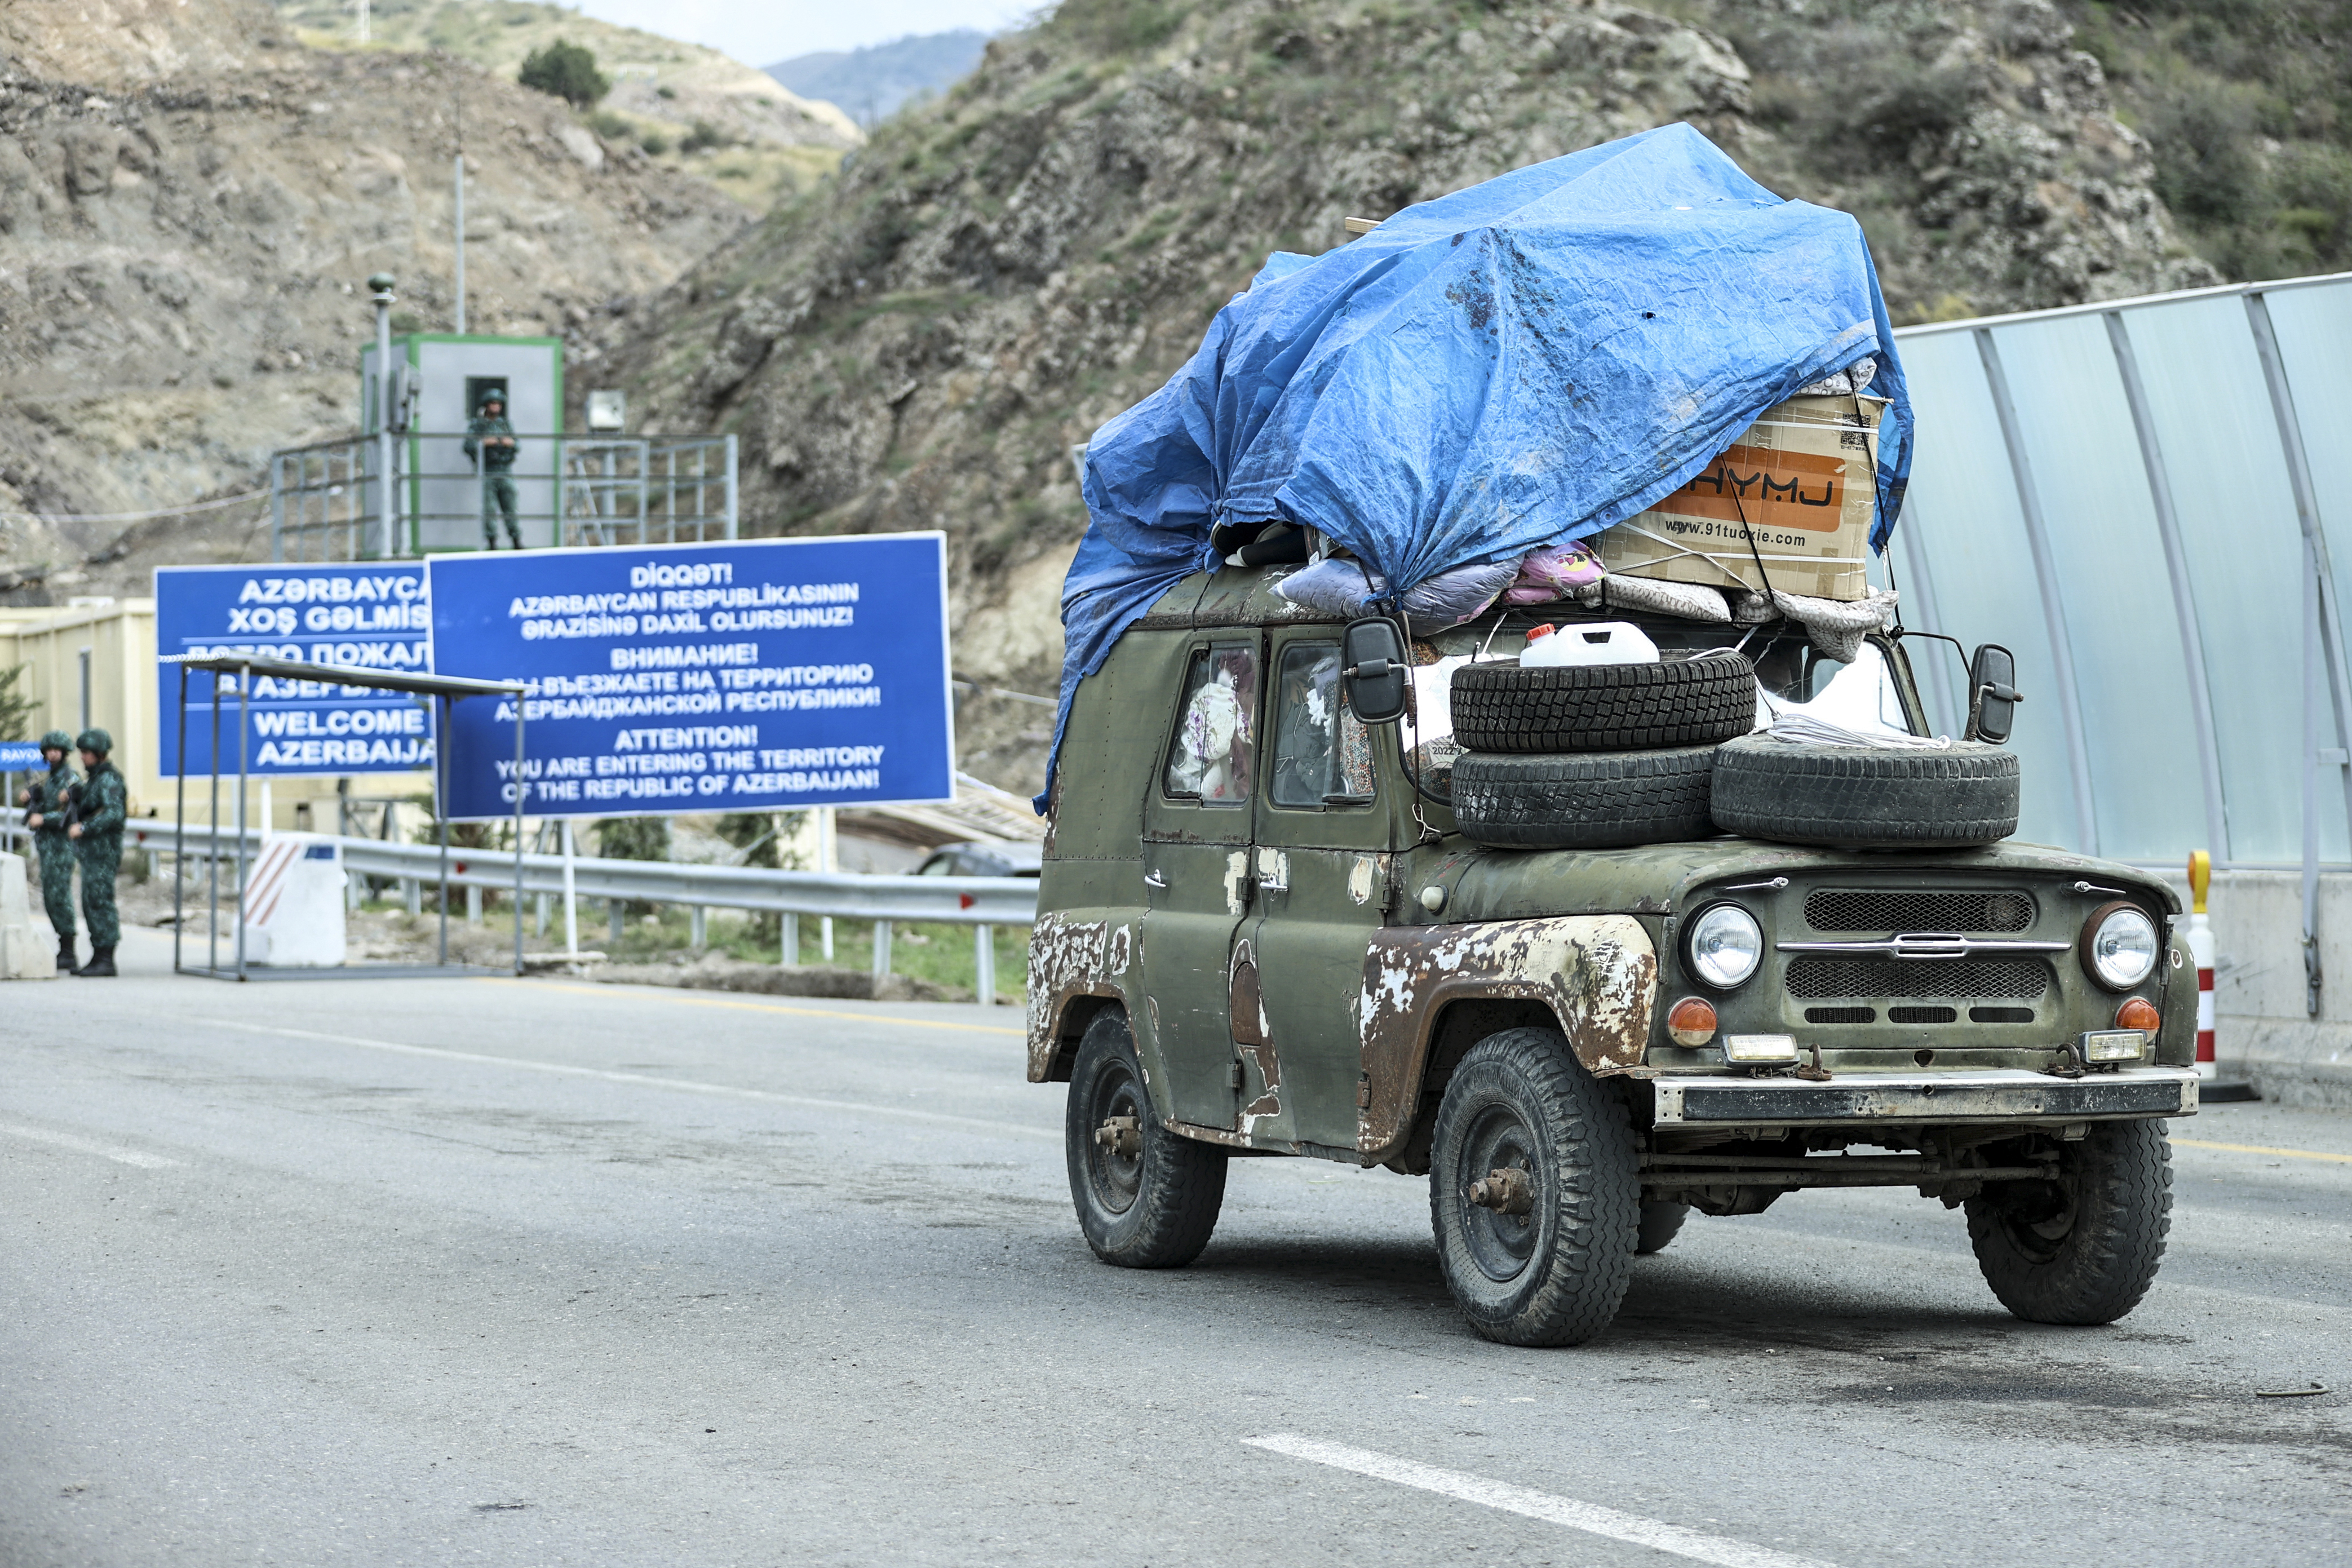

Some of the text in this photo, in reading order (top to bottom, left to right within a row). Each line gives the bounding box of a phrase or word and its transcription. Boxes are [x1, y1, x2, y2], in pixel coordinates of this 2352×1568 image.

[1679, 467, 1833, 506] HYMJ
[631, 561, 733, 588] DİQQƏT!
[508, 582, 860, 618] AZƏRBAYCAN RESPUBLİKASININ
[227, 606, 298, 636] XOŞ
[521, 606, 854, 640] ƏRAZİSİNƏ DAXİL OLURSUNUZ!
[610, 643, 759, 670] ВНИМАНИЕ!
[542, 672, 680, 697] ВЪЕЗЖАЕТЕ
[681, 670, 716, 690] НА
[718, 663, 874, 689] ТЕРРИТОРИЮ
[725, 686, 881, 712] РЕСПУБЛИКИ!
[254, 710, 424, 737] WELCOME
[614, 724, 758, 752] ATTENTION!
[494, 745, 885, 781] YOU ARE ENTERING THE TERRITORY
[1432, 746, 1455, 755] 2022
[501, 768, 880, 803] OF THE REPUBLIC OF AZERBAIJAN!
